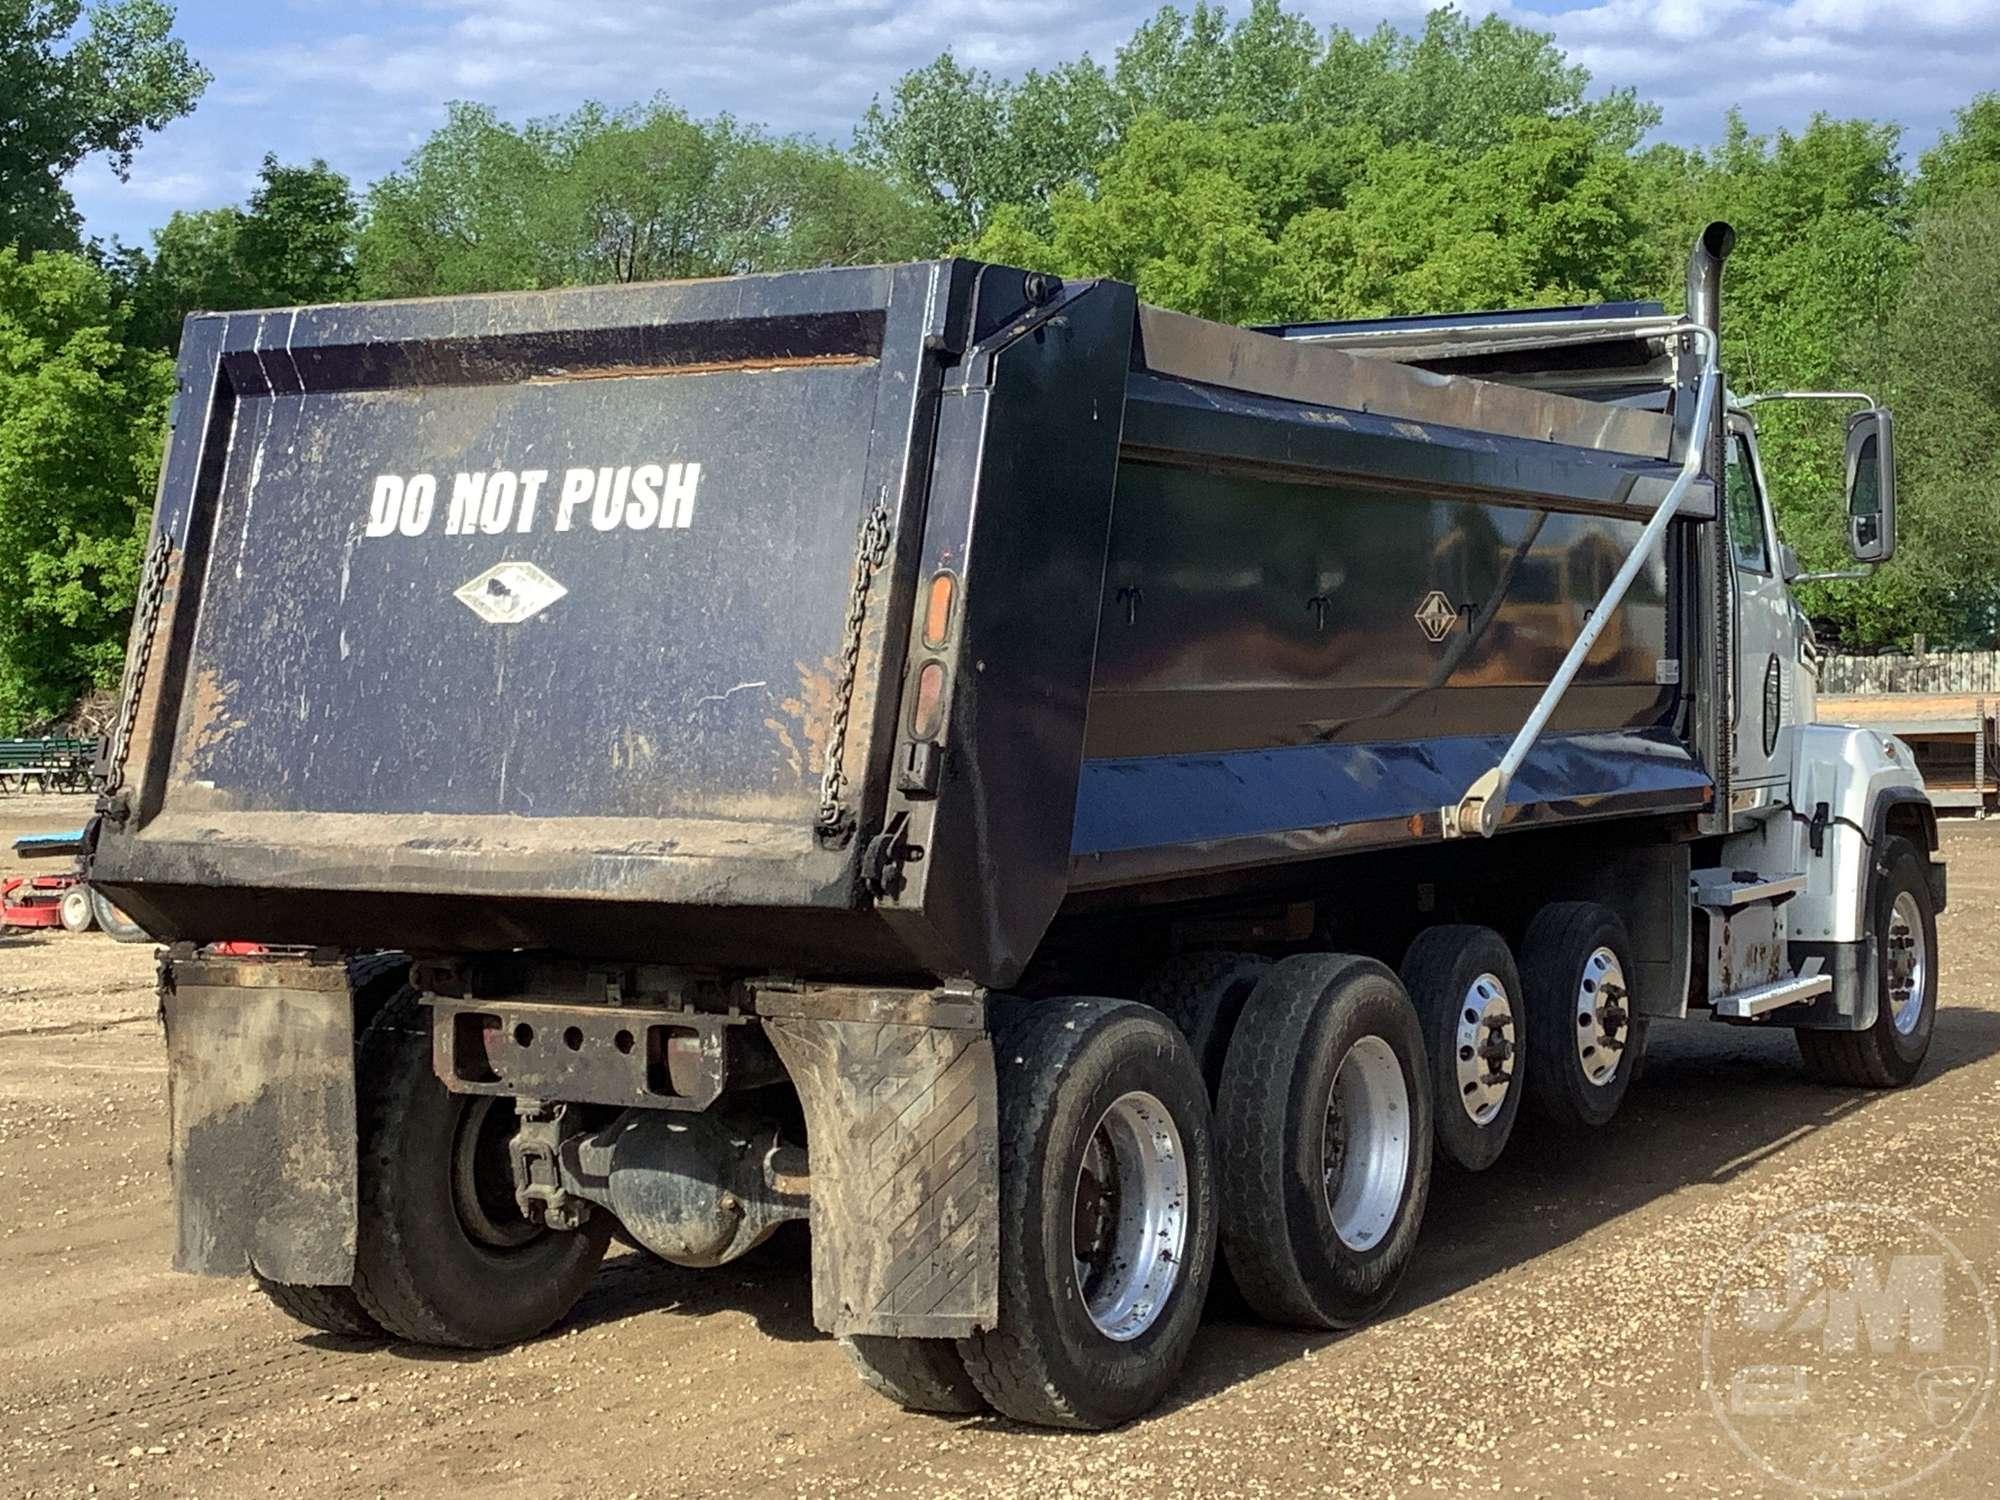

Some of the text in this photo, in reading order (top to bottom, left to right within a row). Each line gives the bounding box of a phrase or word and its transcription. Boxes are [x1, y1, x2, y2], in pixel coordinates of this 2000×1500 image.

[365, 462, 701, 537] DO NOT PUSH
